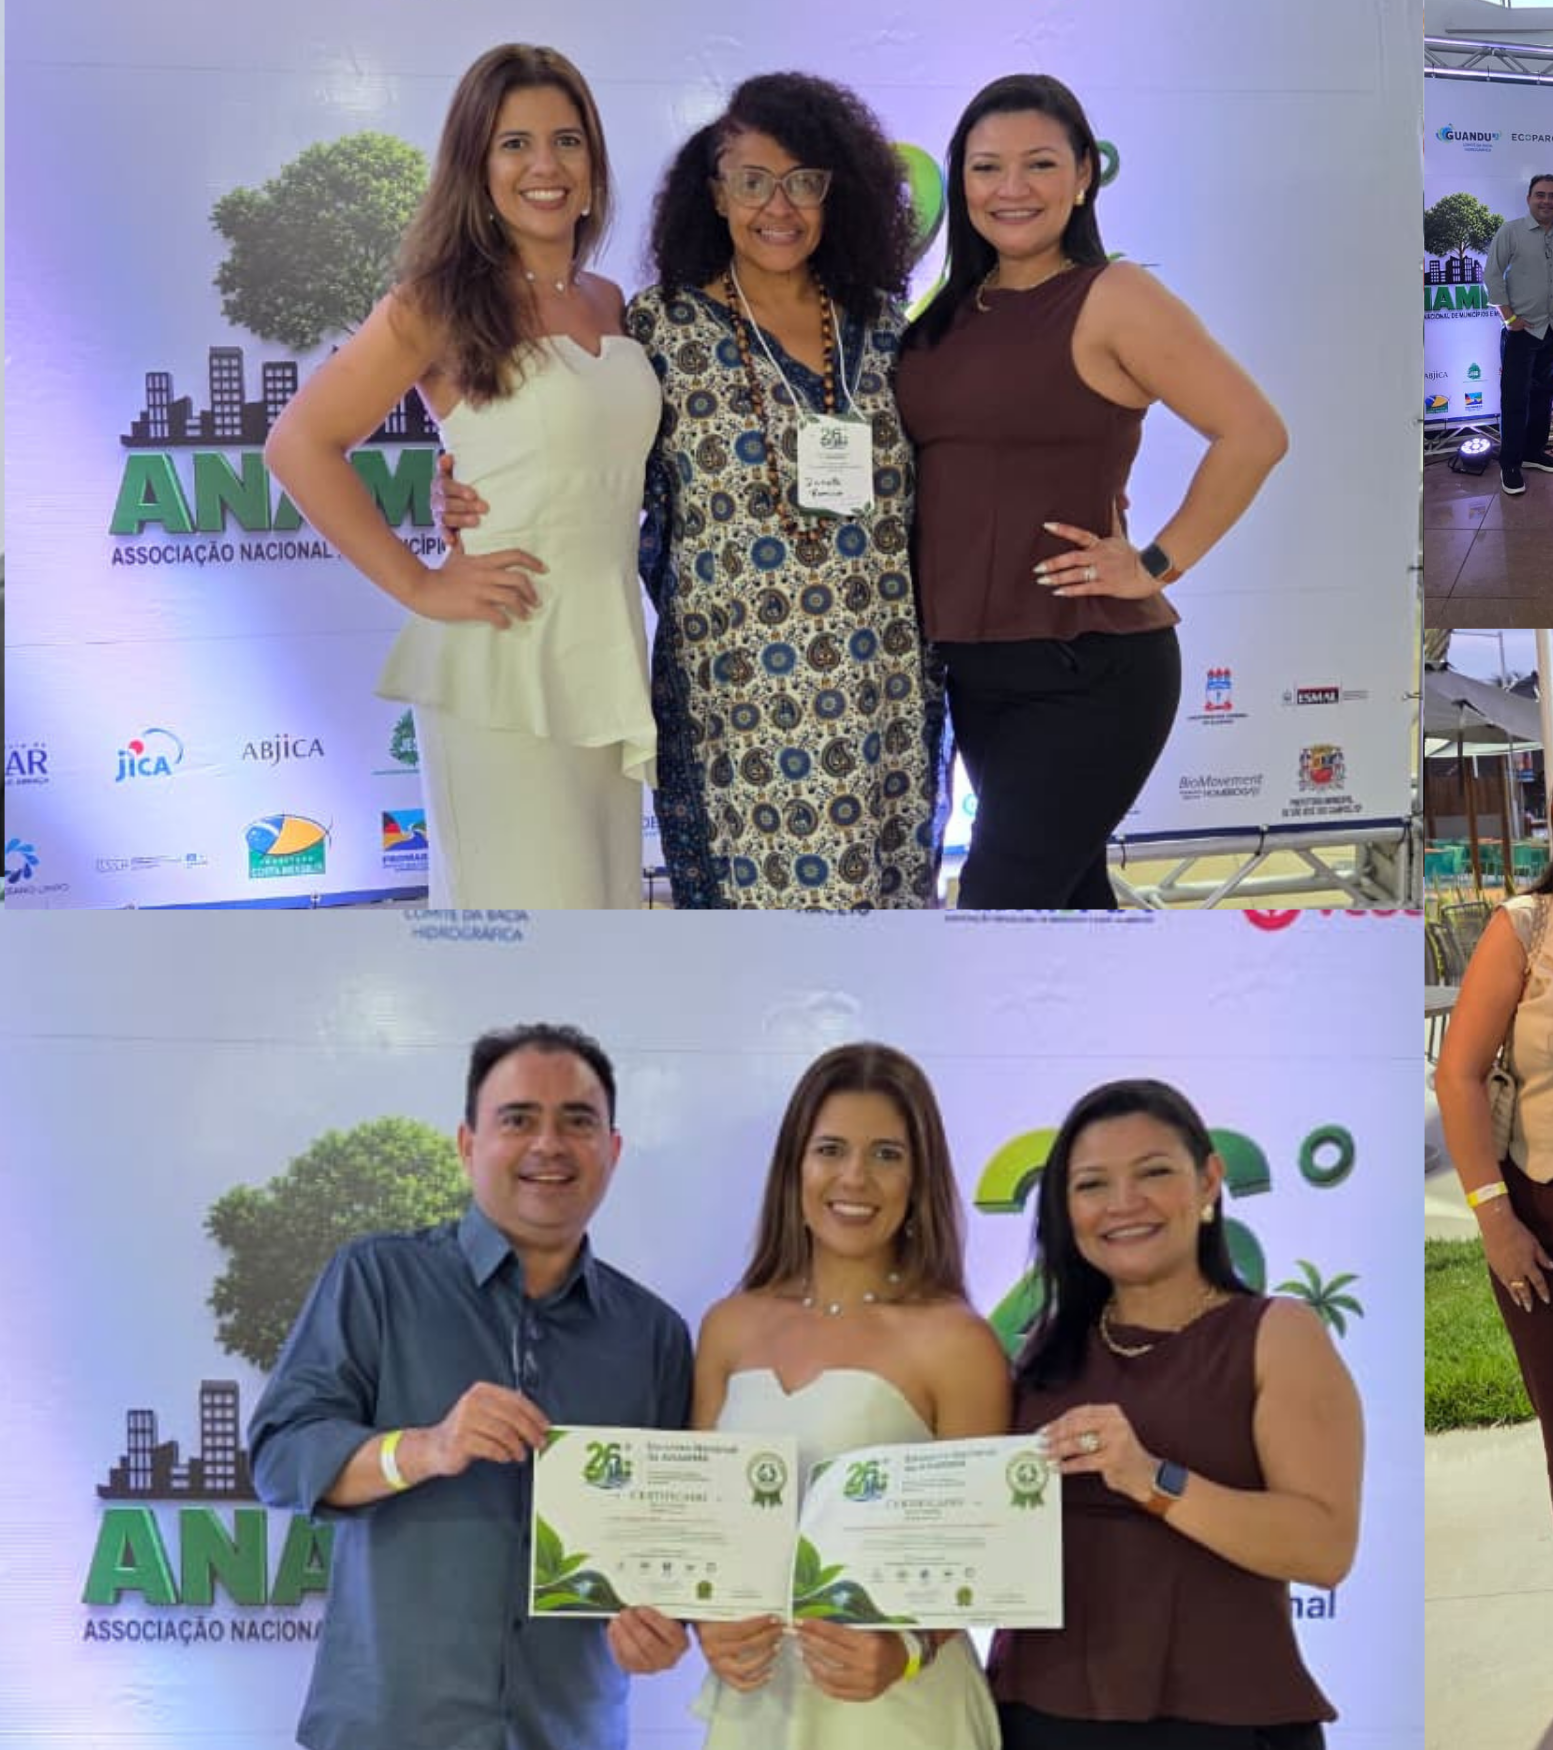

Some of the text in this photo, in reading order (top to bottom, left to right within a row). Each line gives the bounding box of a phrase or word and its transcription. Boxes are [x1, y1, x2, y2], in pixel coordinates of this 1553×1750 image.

[112, 542, 235, 566] ASSOCIAÇÃO
[241, 540, 333, 560] NACIONAL
[1179, 774, 1264, 789] BioMovement
[84, 1616, 224, 1647] ASSOCIAÇÃO
